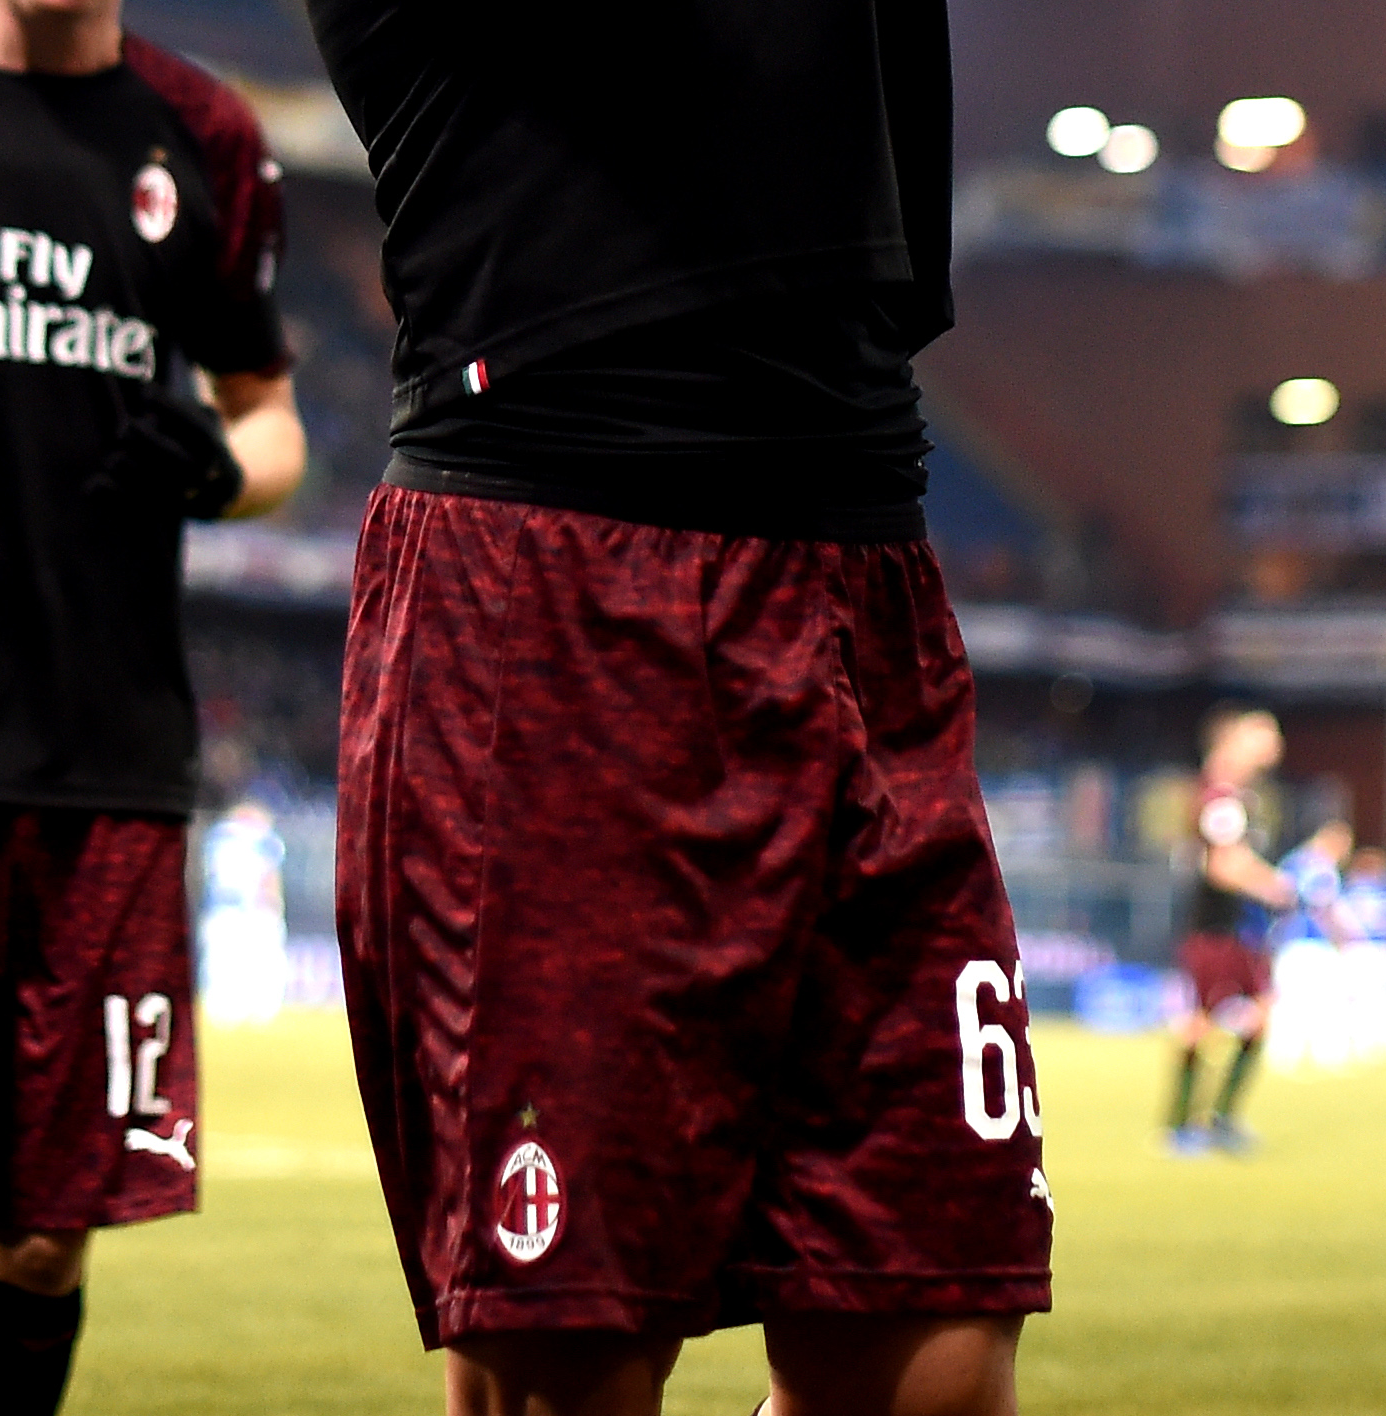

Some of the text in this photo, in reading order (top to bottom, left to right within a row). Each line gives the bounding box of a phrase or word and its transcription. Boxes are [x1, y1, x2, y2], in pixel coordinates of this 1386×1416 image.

[103, 992, 172, 1118] 12
[511, 1145, 546, 1173] ACM
[510, 1235, 545, 1251] 1899
